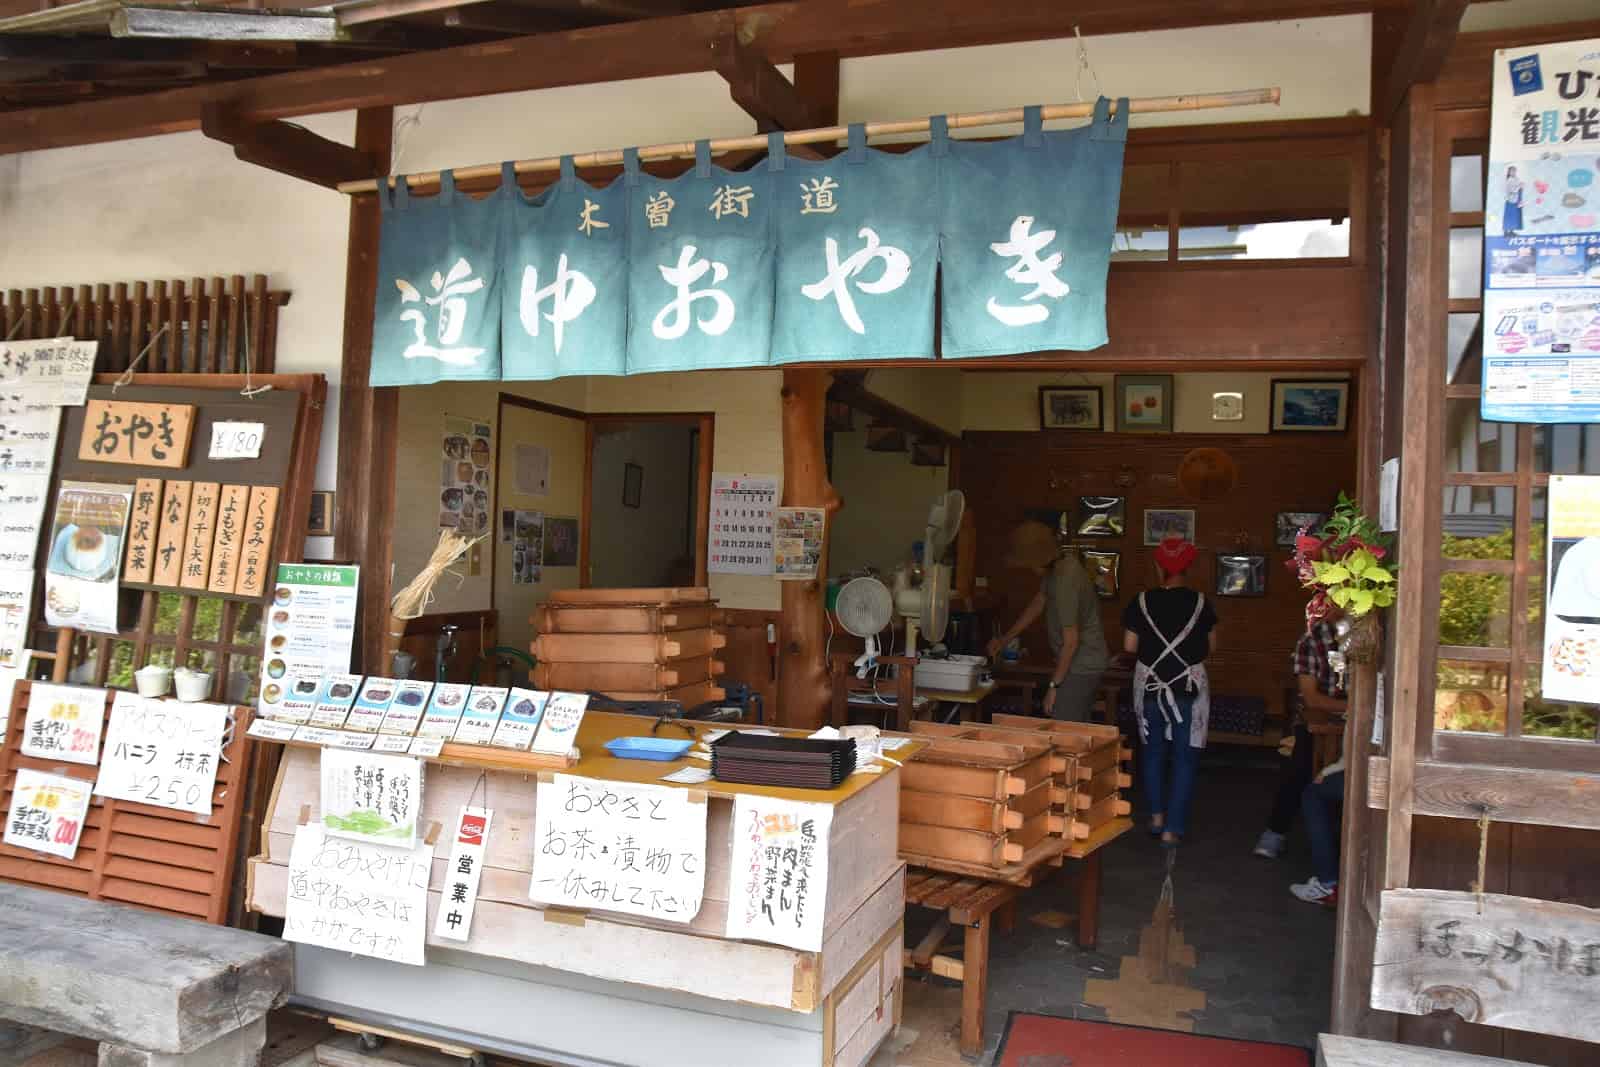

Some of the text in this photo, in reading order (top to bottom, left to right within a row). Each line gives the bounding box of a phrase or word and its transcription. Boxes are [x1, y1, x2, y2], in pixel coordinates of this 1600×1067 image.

[1554, 69, 1600, 100] ひ
[92, 410, 175, 461] おやき
[215, 430, 259, 453] ¥180
[132, 491, 154, 570] 野沢菜
[160, 494, 181, 571] なす
[187, 495, 211, 577] 切り干し大根
[114, 742, 212, 775] バニラ 抹茶
[127, 771, 201, 805] ¥250
[564, 780, 667, 820] おやきと
[311, 833, 428, 889] おみやげに
[779, 846, 798, 912] 肉まん
[289, 868, 414, 923] 道中おやきは
[446, 853, 475, 930] 営業中
[537, 867, 698, 913] 一休みして下さい
[287, 916, 402, 957] いかがですか
